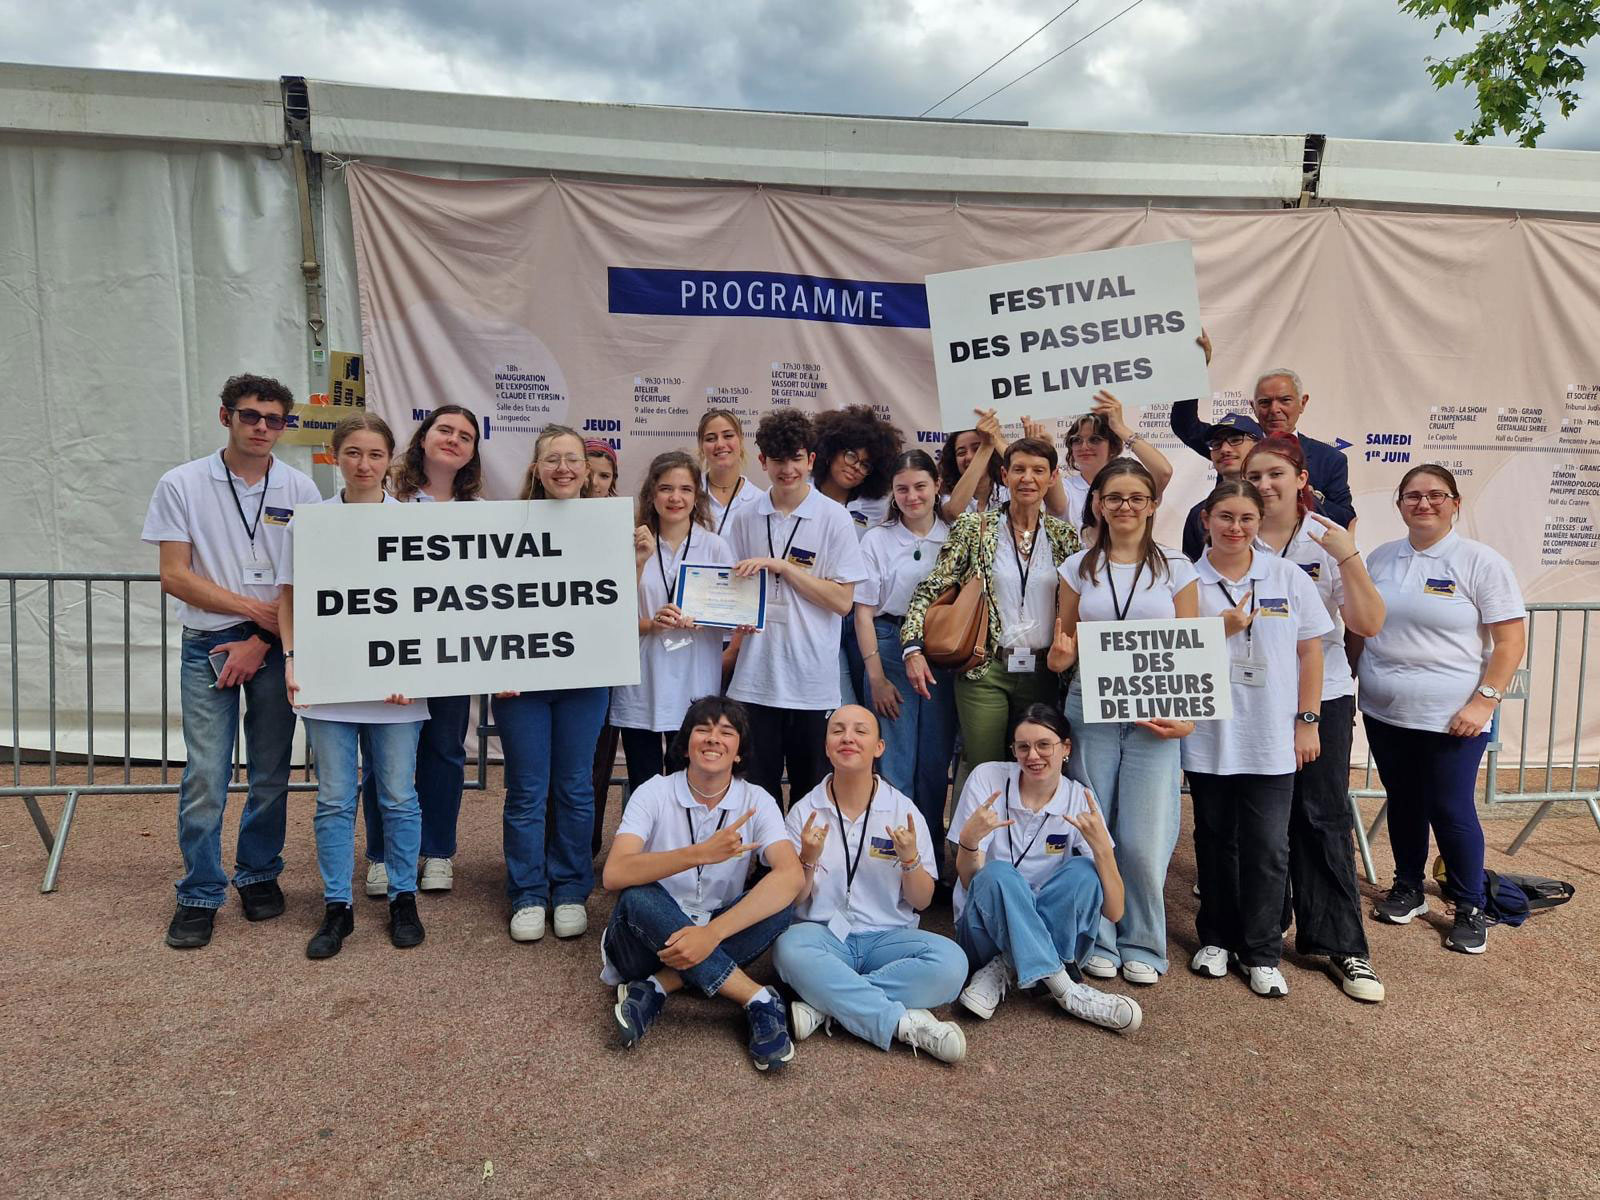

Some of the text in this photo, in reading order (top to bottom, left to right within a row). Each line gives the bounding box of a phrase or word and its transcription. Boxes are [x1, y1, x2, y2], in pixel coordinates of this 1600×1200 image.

[681, 280, 883, 319] PROGRAMME
[989, 275, 1136, 315] FESTIVAL
[950, 310, 1186, 363] DES PASSEURS
[506, 364, 518, 372] 18h
[495, 373, 545, 382] INAUGURATION
[771, 371, 797, 379] LECTURE
[991, 357, 1153, 400] DE LIVRES
[495, 382, 549, 392] DE L'EXPOSITION
[771, 380, 799, 388] VASSORT
[501, 391, 527, 400] CLAUDE
[528, 392, 535, 400] ET
[537, 393, 560, 401] YERSIN
[781, 389, 817, 397] GEETANJALI
[634, 394, 671, 402] D'ÉCRITURE
[496, 403, 511, 411] Salle
[513, 403, 524, 412] des
[1212, 399, 1239, 407] FIGURES
[1467, 406, 1487, 414] SHOAH
[497, 413, 531, 422] Languedoc
[1438, 414, 1477, 422] L'IMPENSABLE
[1497, 414, 1519, 423] TÉMOIN
[303, 419, 337, 430] MÉDIATH
[582, 418, 621, 431] JEUDI
[1429, 422, 1455, 430] CRUAUTÉ
[1496, 424, 1528, 432] GEETANJALI
[1560, 426, 1582, 434] MINOT
[1366, 433, 1412, 446] SAMEDI
[1435, 434, 1457, 442] Capitole
[1381, 451, 1411, 463] JUIN
[1552, 471, 1577, 479] TÉMOIN
[1559, 498, 1567, 506] du
[1569, 516, 1587, 524] DIEUX
[1551, 523, 1576, 531] DÉESSES
[378, 532, 562, 562] FESTIVAL
[1550, 540, 1590, 548] COMPRENDRE
[1541, 558, 1558, 567] Espace
[317, 579, 619, 616] DES PASSEURS
[1100, 629, 1205, 652] FESTIVAL
[368, 631, 575, 667] DE LIVRES
[1132, 652, 1175, 673] DES
[1098, 673, 1215, 696] PASSEURS
[1100, 696, 1216, 719] DE LIVRES
